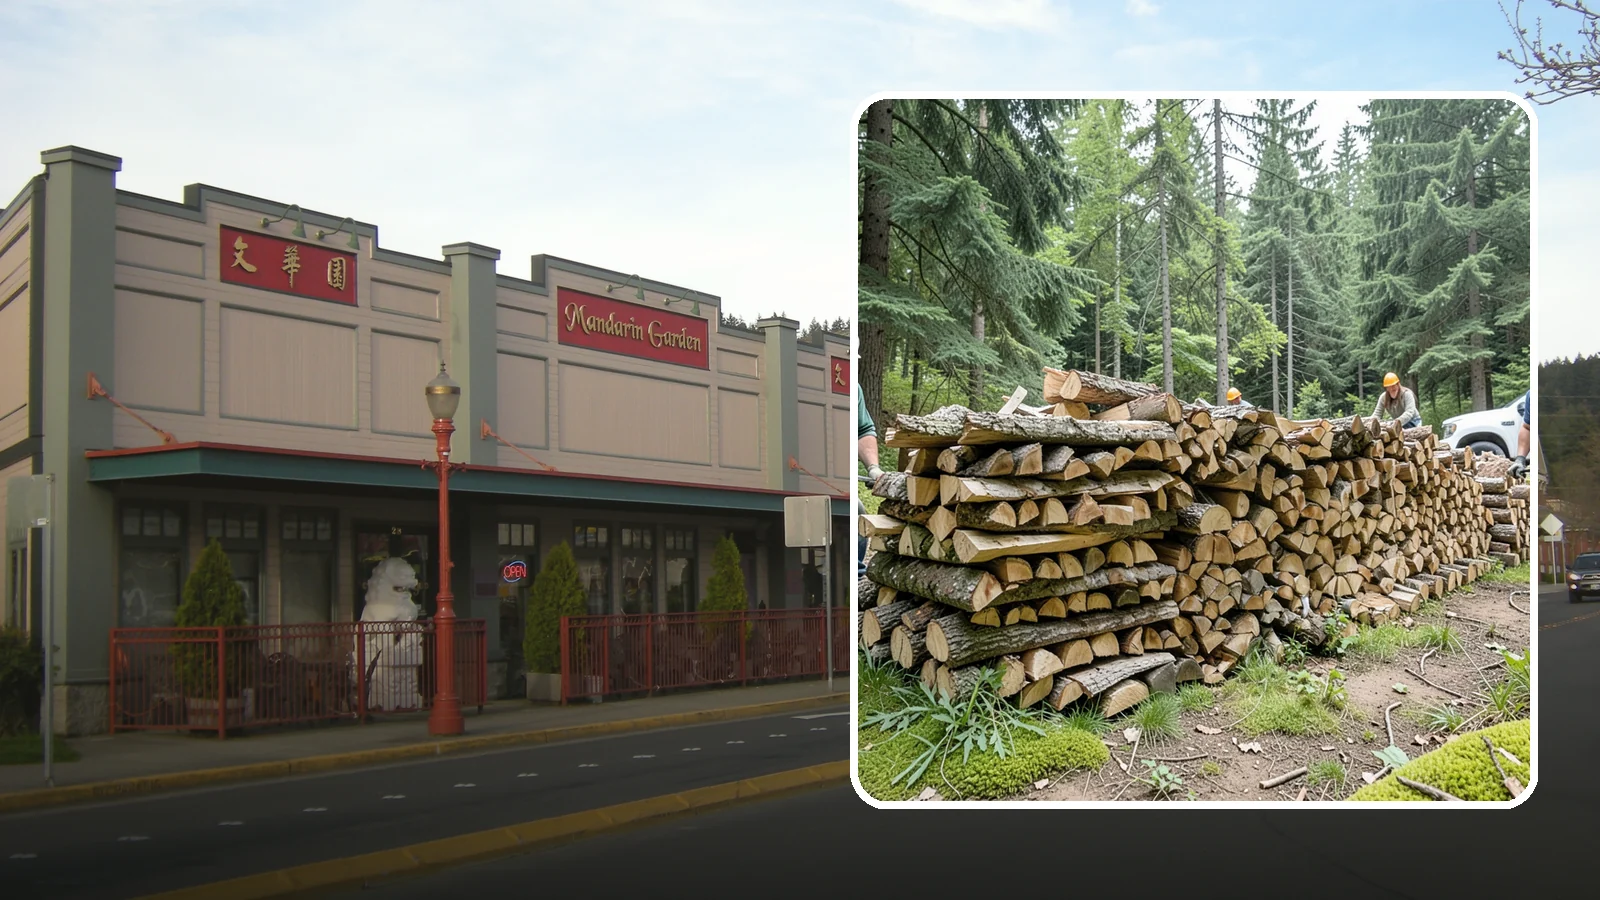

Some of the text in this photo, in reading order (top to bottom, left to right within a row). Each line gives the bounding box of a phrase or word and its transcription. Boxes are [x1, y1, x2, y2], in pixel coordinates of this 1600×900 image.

[230, 235, 347, 291] 文華園
[564, 302, 702, 352] Mandarin Garden
[834, 363, 846, 386] 文
[503, 565, 527, 578] OPEN
